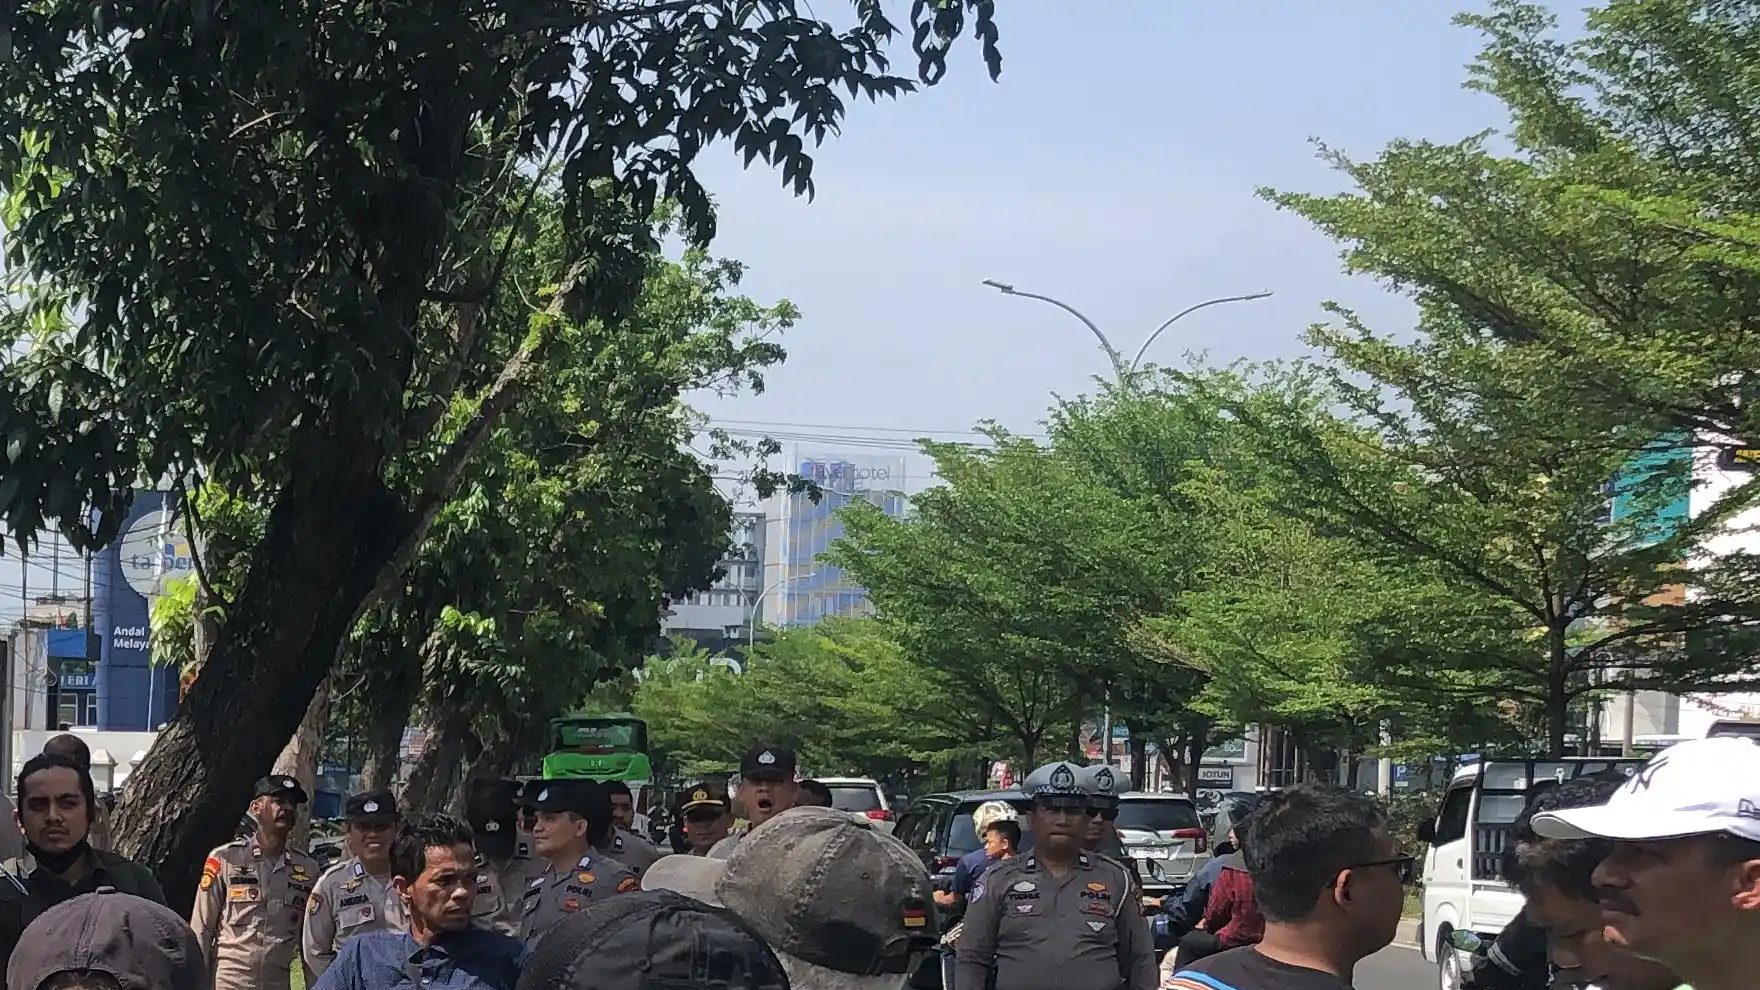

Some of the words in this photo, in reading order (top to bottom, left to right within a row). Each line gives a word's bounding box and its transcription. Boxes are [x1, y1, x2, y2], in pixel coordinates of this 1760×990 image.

[113, 626, 145, 637] Andal
[566, 884, 593, 898] POLRI
[1080, 890, 1111, 901] POLRI
